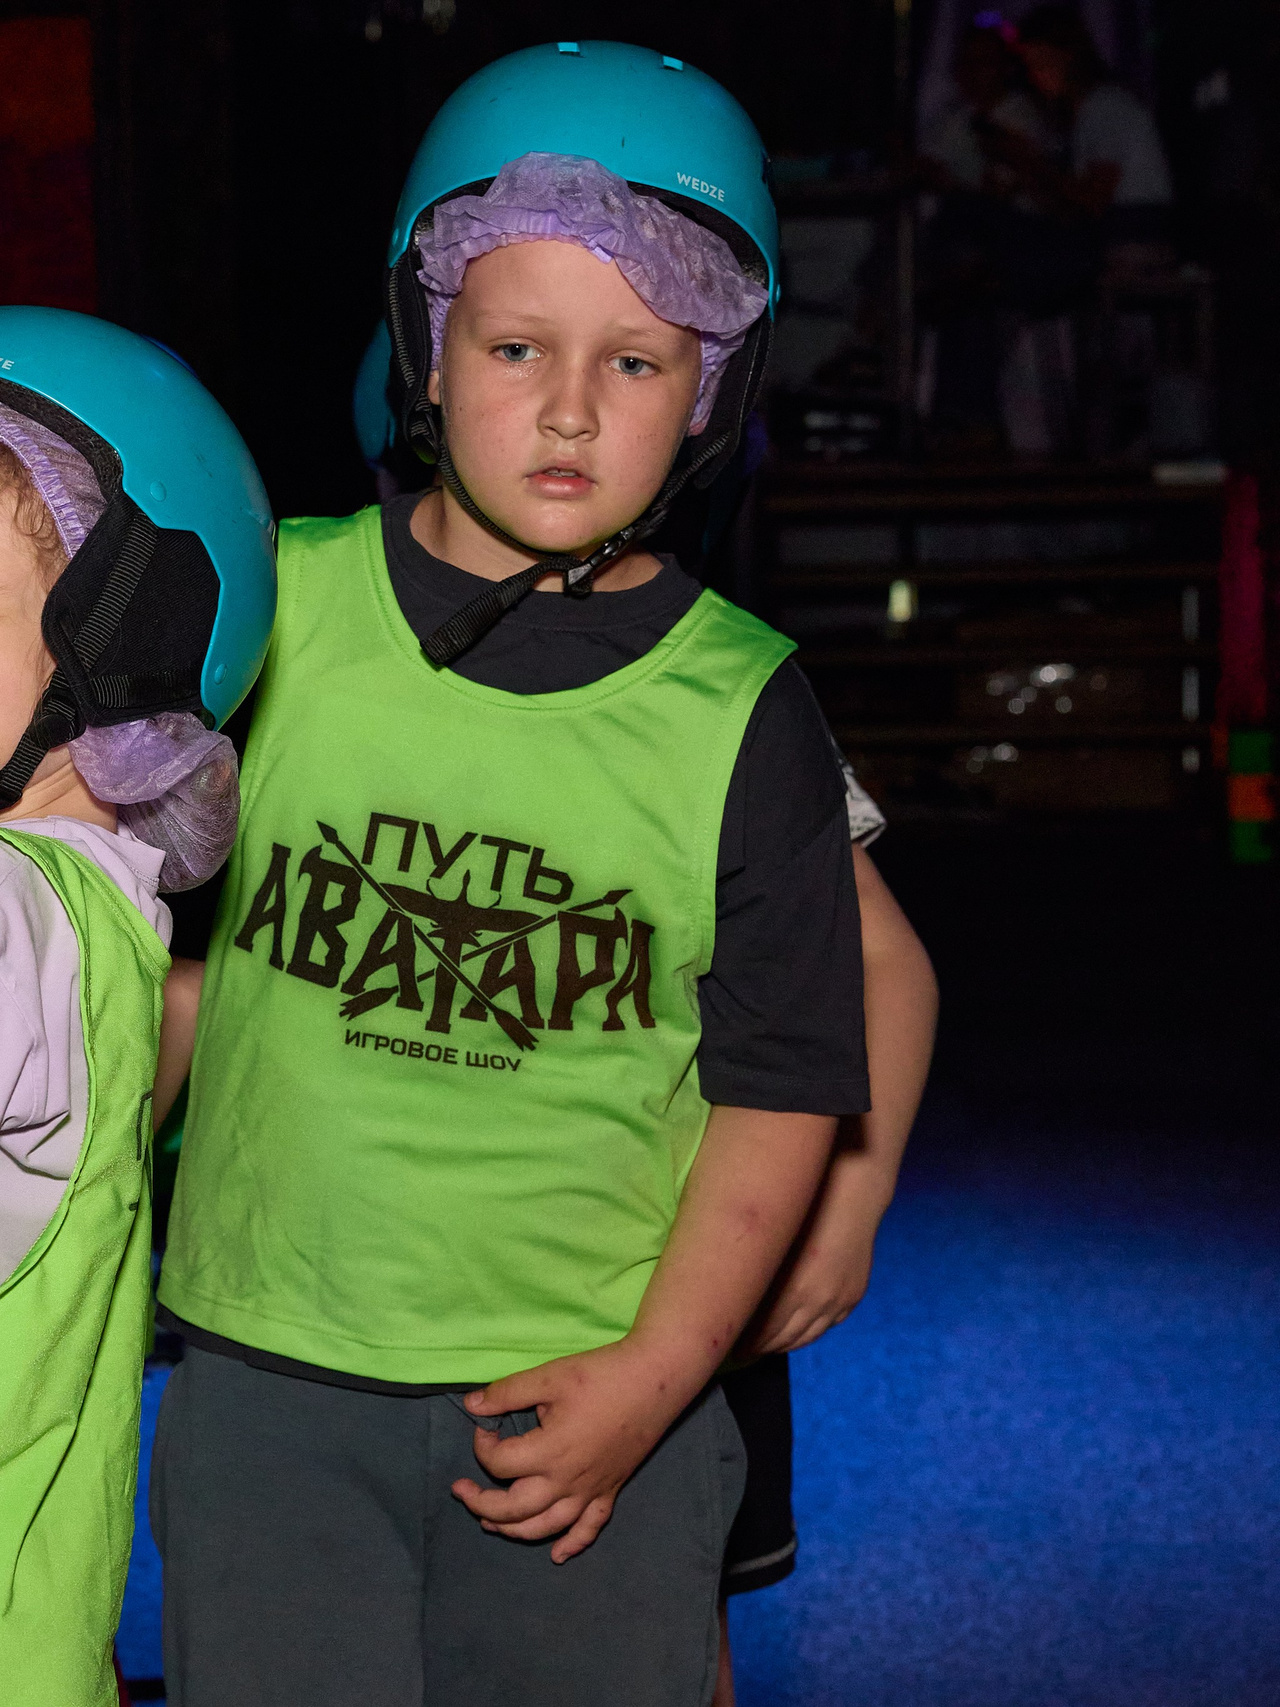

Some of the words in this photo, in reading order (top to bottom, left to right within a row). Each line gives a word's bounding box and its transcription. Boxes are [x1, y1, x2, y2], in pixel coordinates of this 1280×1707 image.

[677, 172, 725, 202] WEDZE
[361, 811, 575, 905] ПУТЬ
[234, 842, 657, 1034] АВАТАРА
[345, 1029, 459, 1064] ИГРОВОЕ
[466, 1050, 522, 1072] ШОУ
